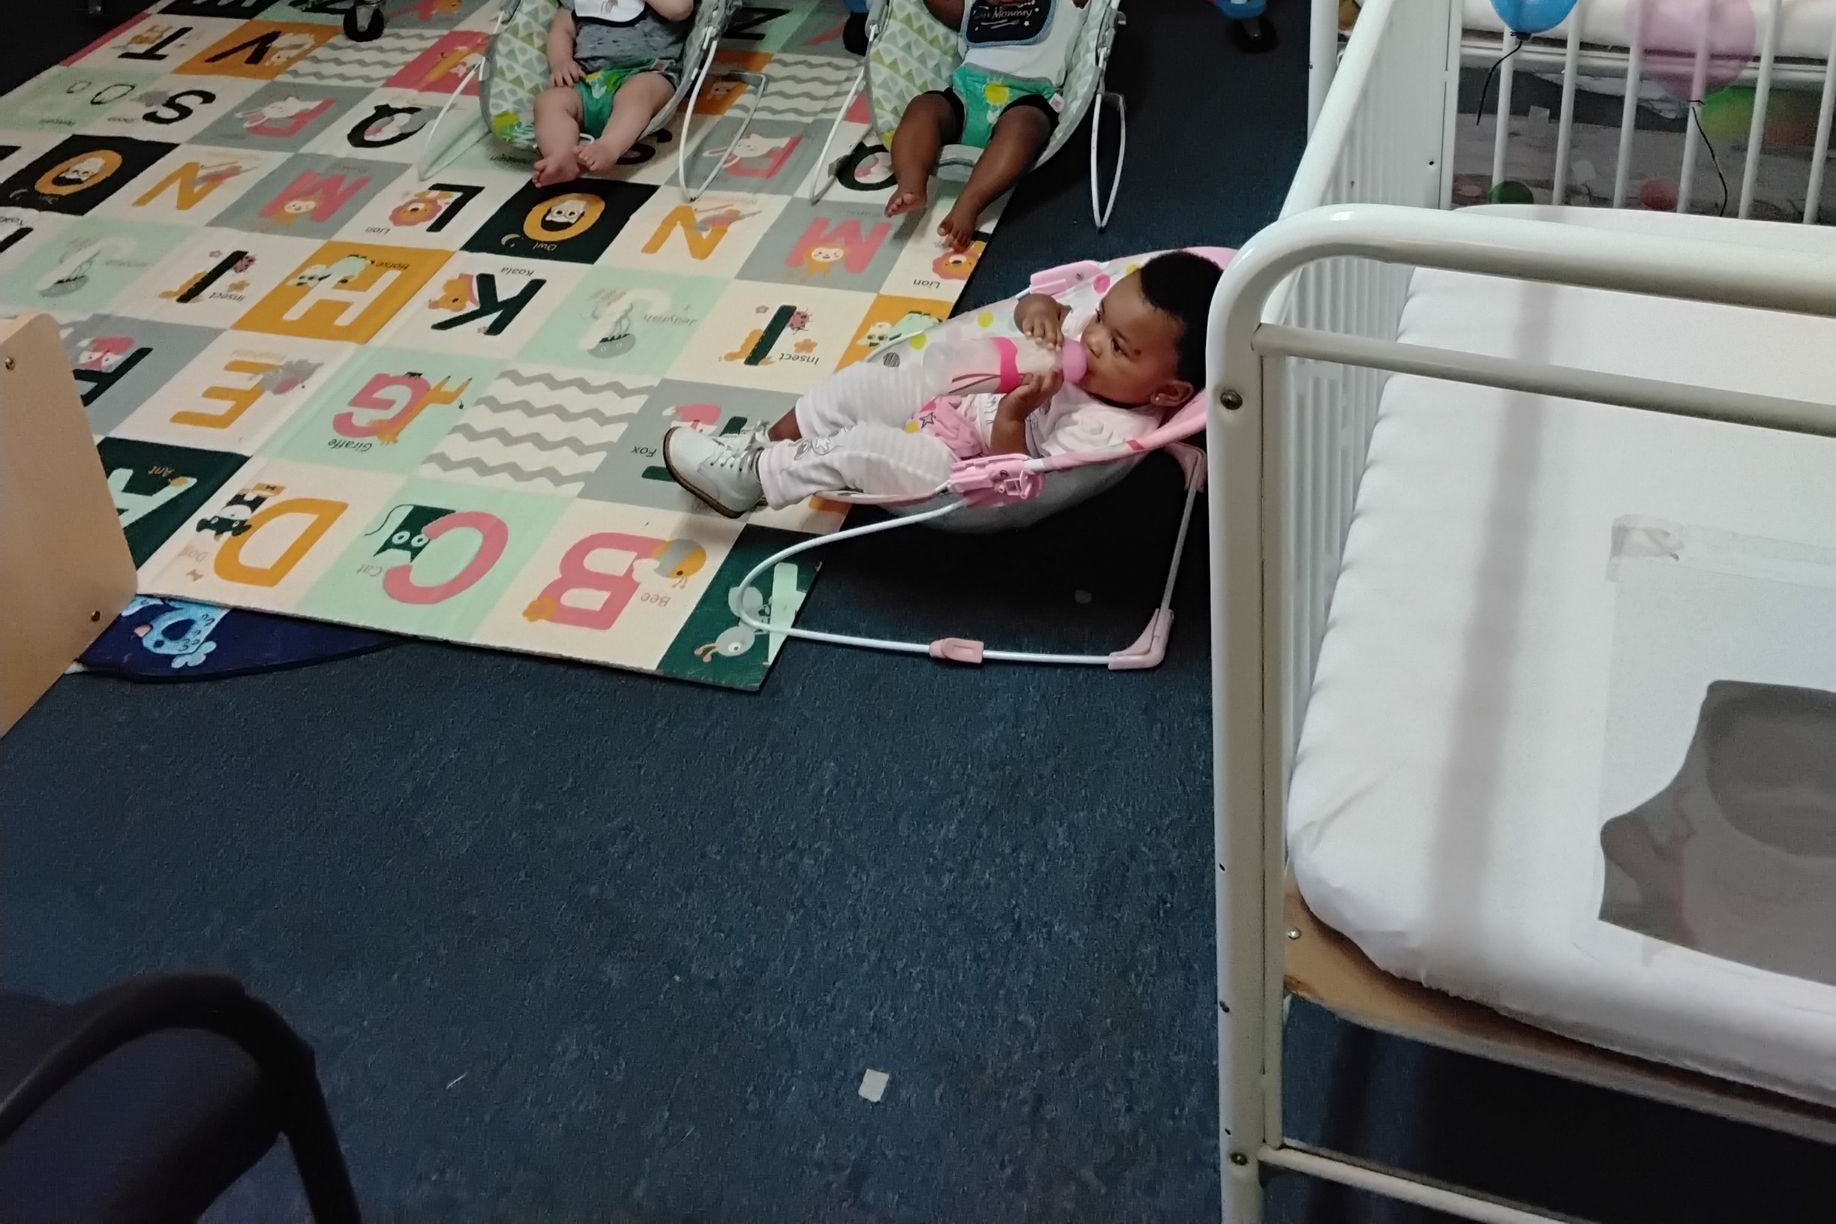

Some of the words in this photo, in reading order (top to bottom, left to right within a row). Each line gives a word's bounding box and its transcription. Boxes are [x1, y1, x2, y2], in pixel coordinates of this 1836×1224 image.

[117, 27, 194, 61] T
[142, 89, 217, 125] S
[131, 161, 225, 211] N
[426, 182, 486, 233] L
[523, 192, 606, 242] O
[532, 242, 558, 251] Owl
[641, 204, 729, 260] N
[785, 216, 892, 273] M
[375, 259, 411, 271] Horse
[501, 266, 535, 276] Koala
[282, 269, 402, 326] H
[912, 278, 942, 289] Lion
[431, 273, 547, 336] K
[779, 352, 821, 365] Insect
[332, 373, 431, 438] G
[328, 437, 373, 452] Giraffe
[631, 446, 658, 458] Fox
[148, 465, 175, 475] Ant
[213, 497, 348, 587] D
[383, 511, 509, 605] C
[356, 562, 384, 577] Cat
[530, 532, 672, 630] B
[641, 591, 672, 608] Bee
